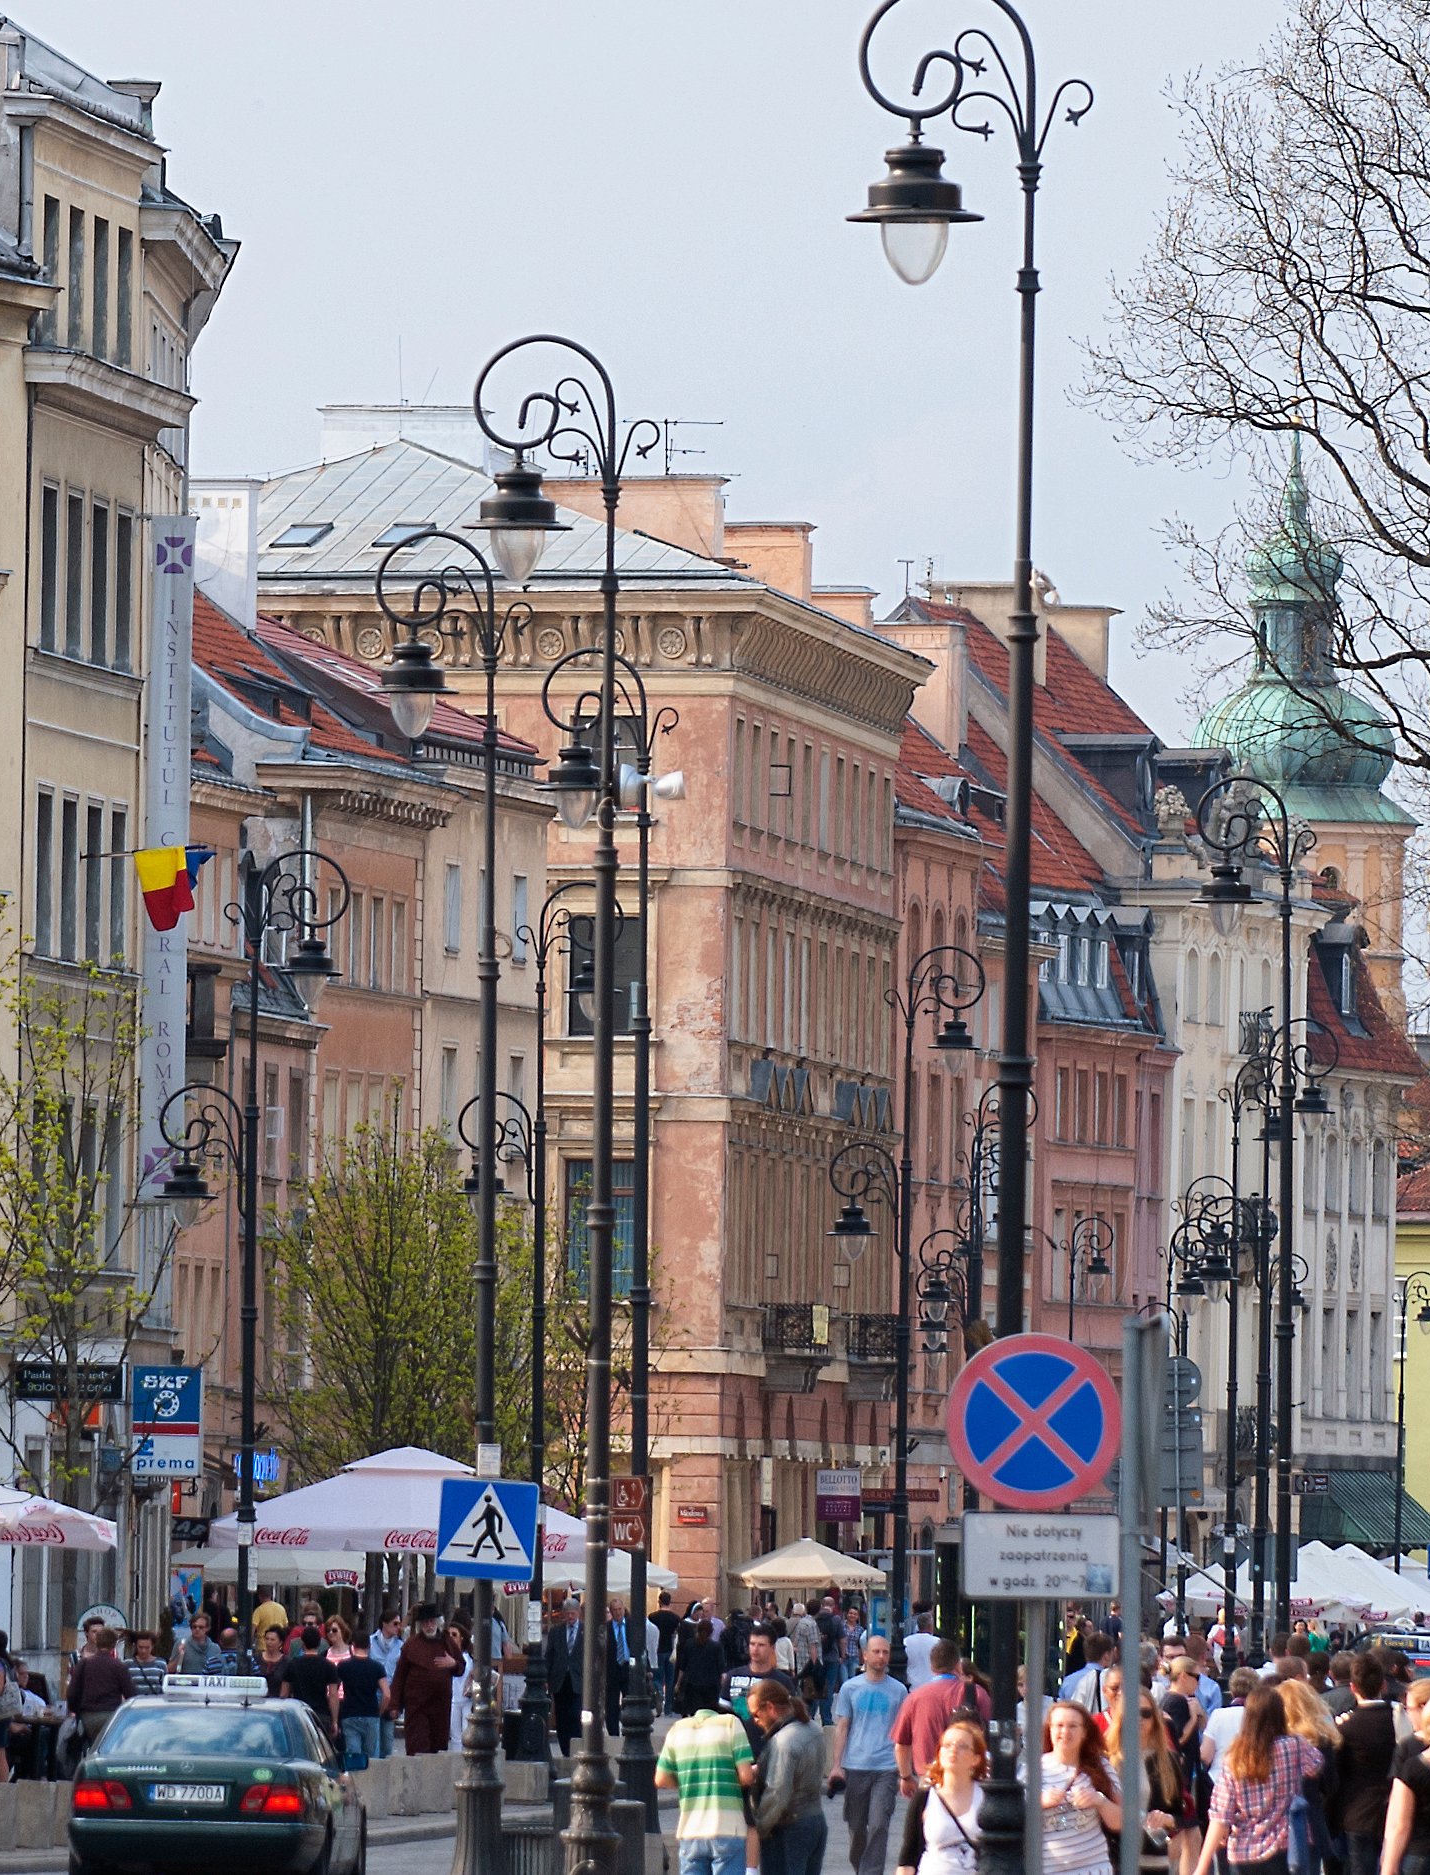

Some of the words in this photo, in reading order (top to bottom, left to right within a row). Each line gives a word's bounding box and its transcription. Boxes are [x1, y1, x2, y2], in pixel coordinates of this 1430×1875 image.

[161, 599, 180, 805] INSTITUTUL
[143, 1375, 189, 1389] SKF
[137, 1459, 195, 1471] prema
[614, 1522, 632, 1540] WC
[1006, 1525, 1029, 1537] Nie
[1033, 1524, 1082, 1540] dotyczy
[999, 1549, 1088, 1564] zaopatrzenia
[989, 1577, 998, 1587] w
[1003, 1574, 1040, 1590] godz.
[204, 1676, 227, 1688] TAXI
[156, 1786, 176, 1800] WD
[181, 1786, 222, 1800] 7700A
